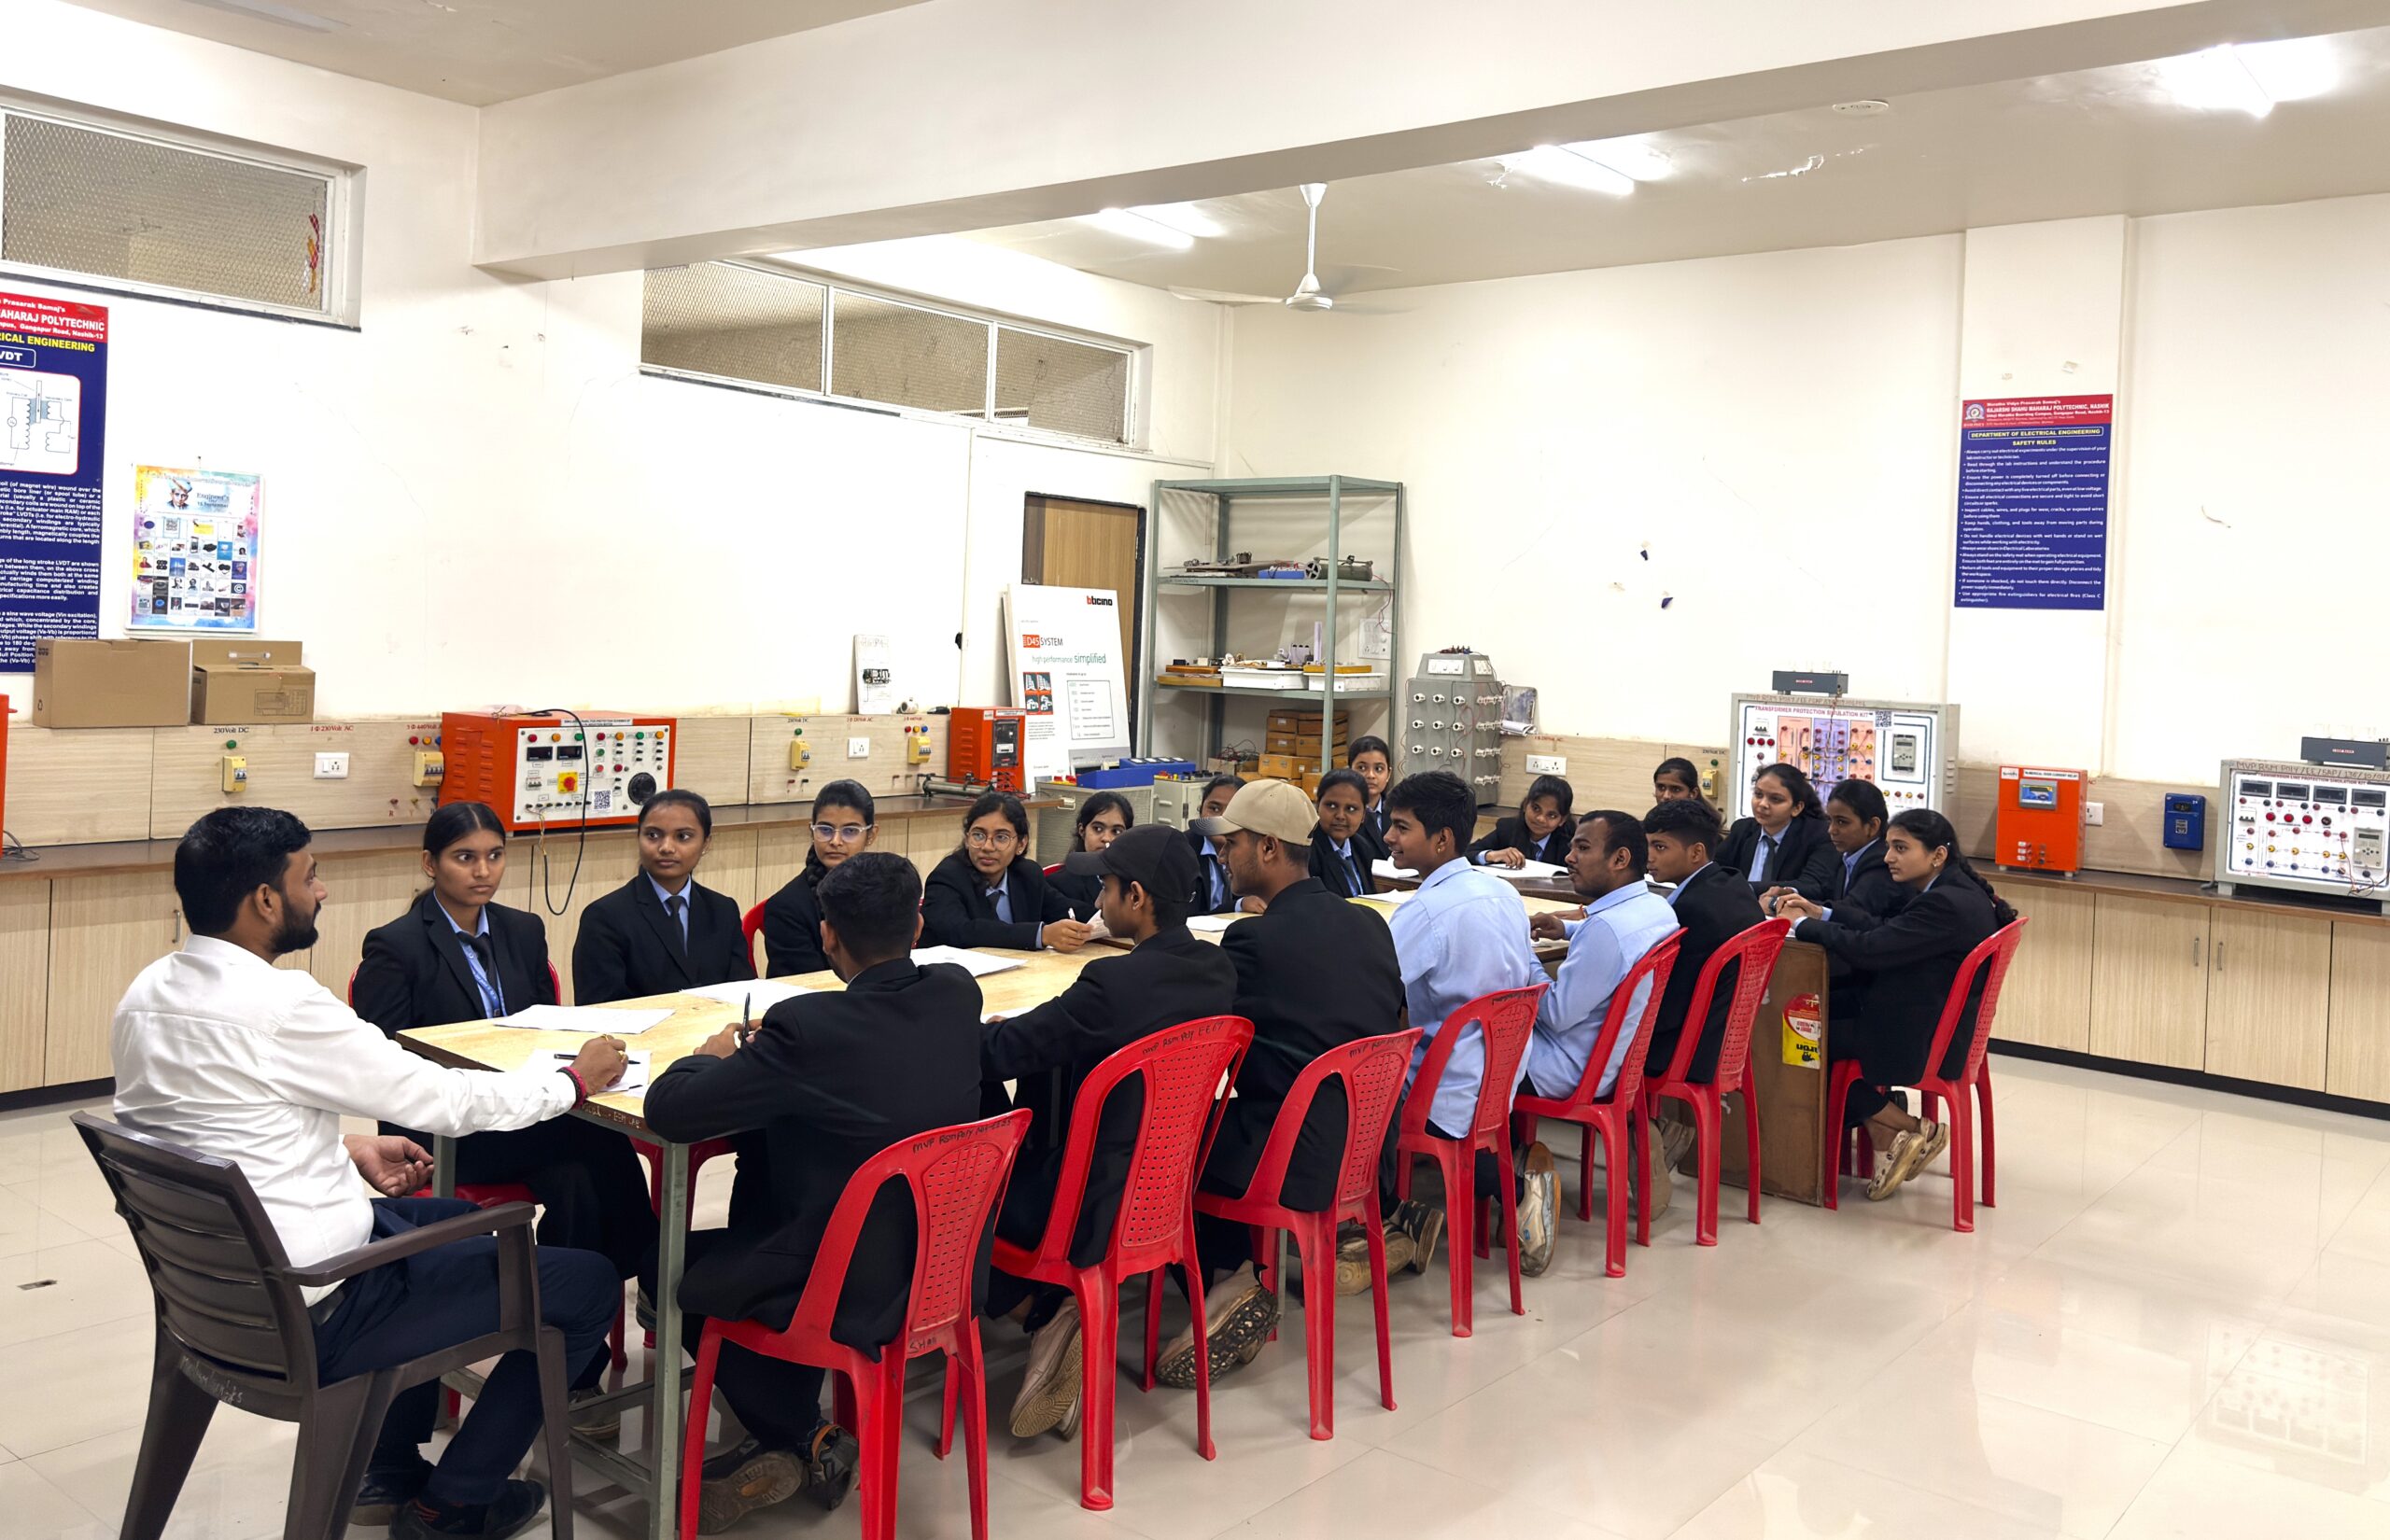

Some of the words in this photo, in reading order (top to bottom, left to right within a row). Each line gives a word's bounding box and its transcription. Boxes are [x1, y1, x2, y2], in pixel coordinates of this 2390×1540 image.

[3, 299, 35, 308] Prasarak
[38, 304, 65, 313] Samaj's
[0, 309, 38, 322] AHARAJ
[42, 315, 104, 331] POLYTECHNIC
[20, 323, 51, 333] Gangapur
[53, 328, 70, 336] Road,
[73, 330, 103, 339] Nashik-13
[28, 336, 95, 352] ENGINEERING
[31, 524, 67, 532] ferromagnetic
[1040, 637, 1063, 646] SYSTEM
[1032, 655, 1043, 664] high
[1074, 653, 1106, 665] simplified
